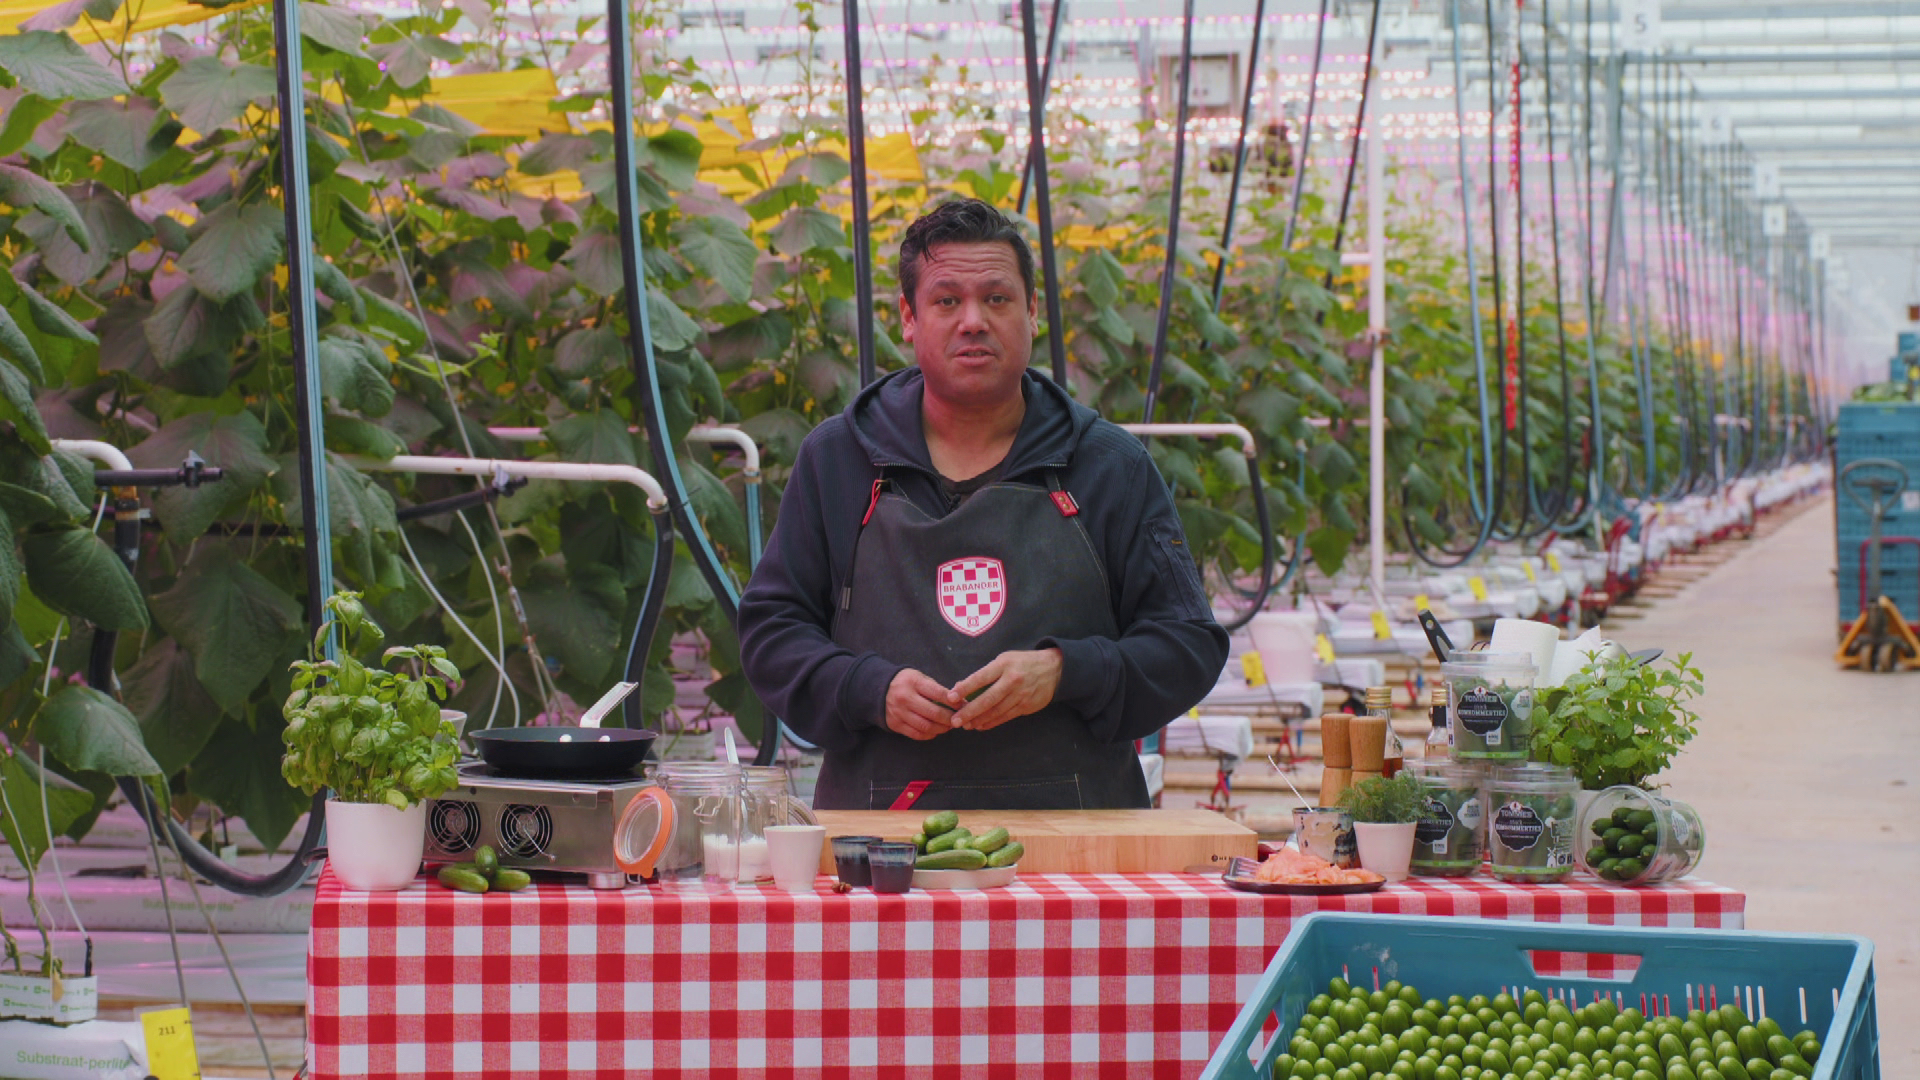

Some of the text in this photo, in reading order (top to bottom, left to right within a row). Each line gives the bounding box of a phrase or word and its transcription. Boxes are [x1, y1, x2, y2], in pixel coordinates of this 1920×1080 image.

[1634, 12, 1647, 34] 5
[943, 581, 999, 593] BRABANDER
[158, 1025, 176, 1036] 211
